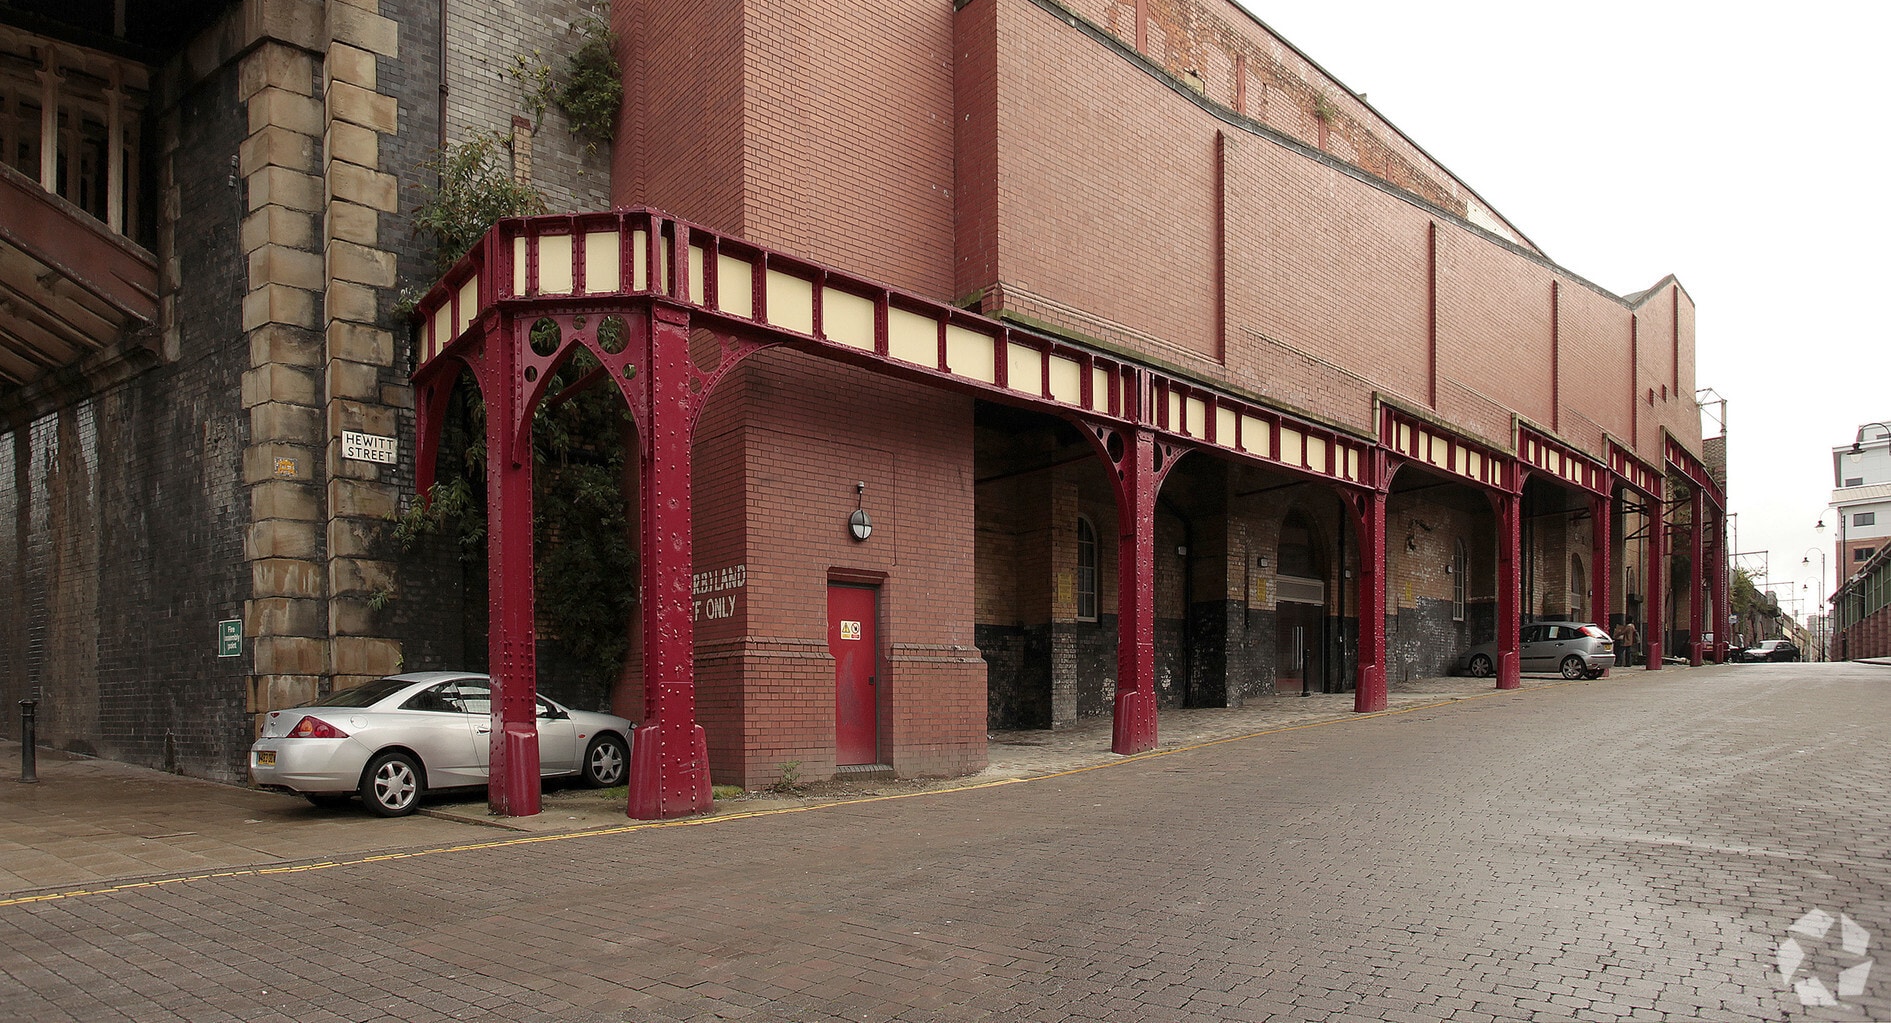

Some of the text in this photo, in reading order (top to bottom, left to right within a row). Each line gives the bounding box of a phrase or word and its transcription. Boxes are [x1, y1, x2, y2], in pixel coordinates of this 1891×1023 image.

[346, 434, 393, 450] HEWITT
[348, 447, 392, 462] STREET
[706, 595, 736, 620] ONLY
